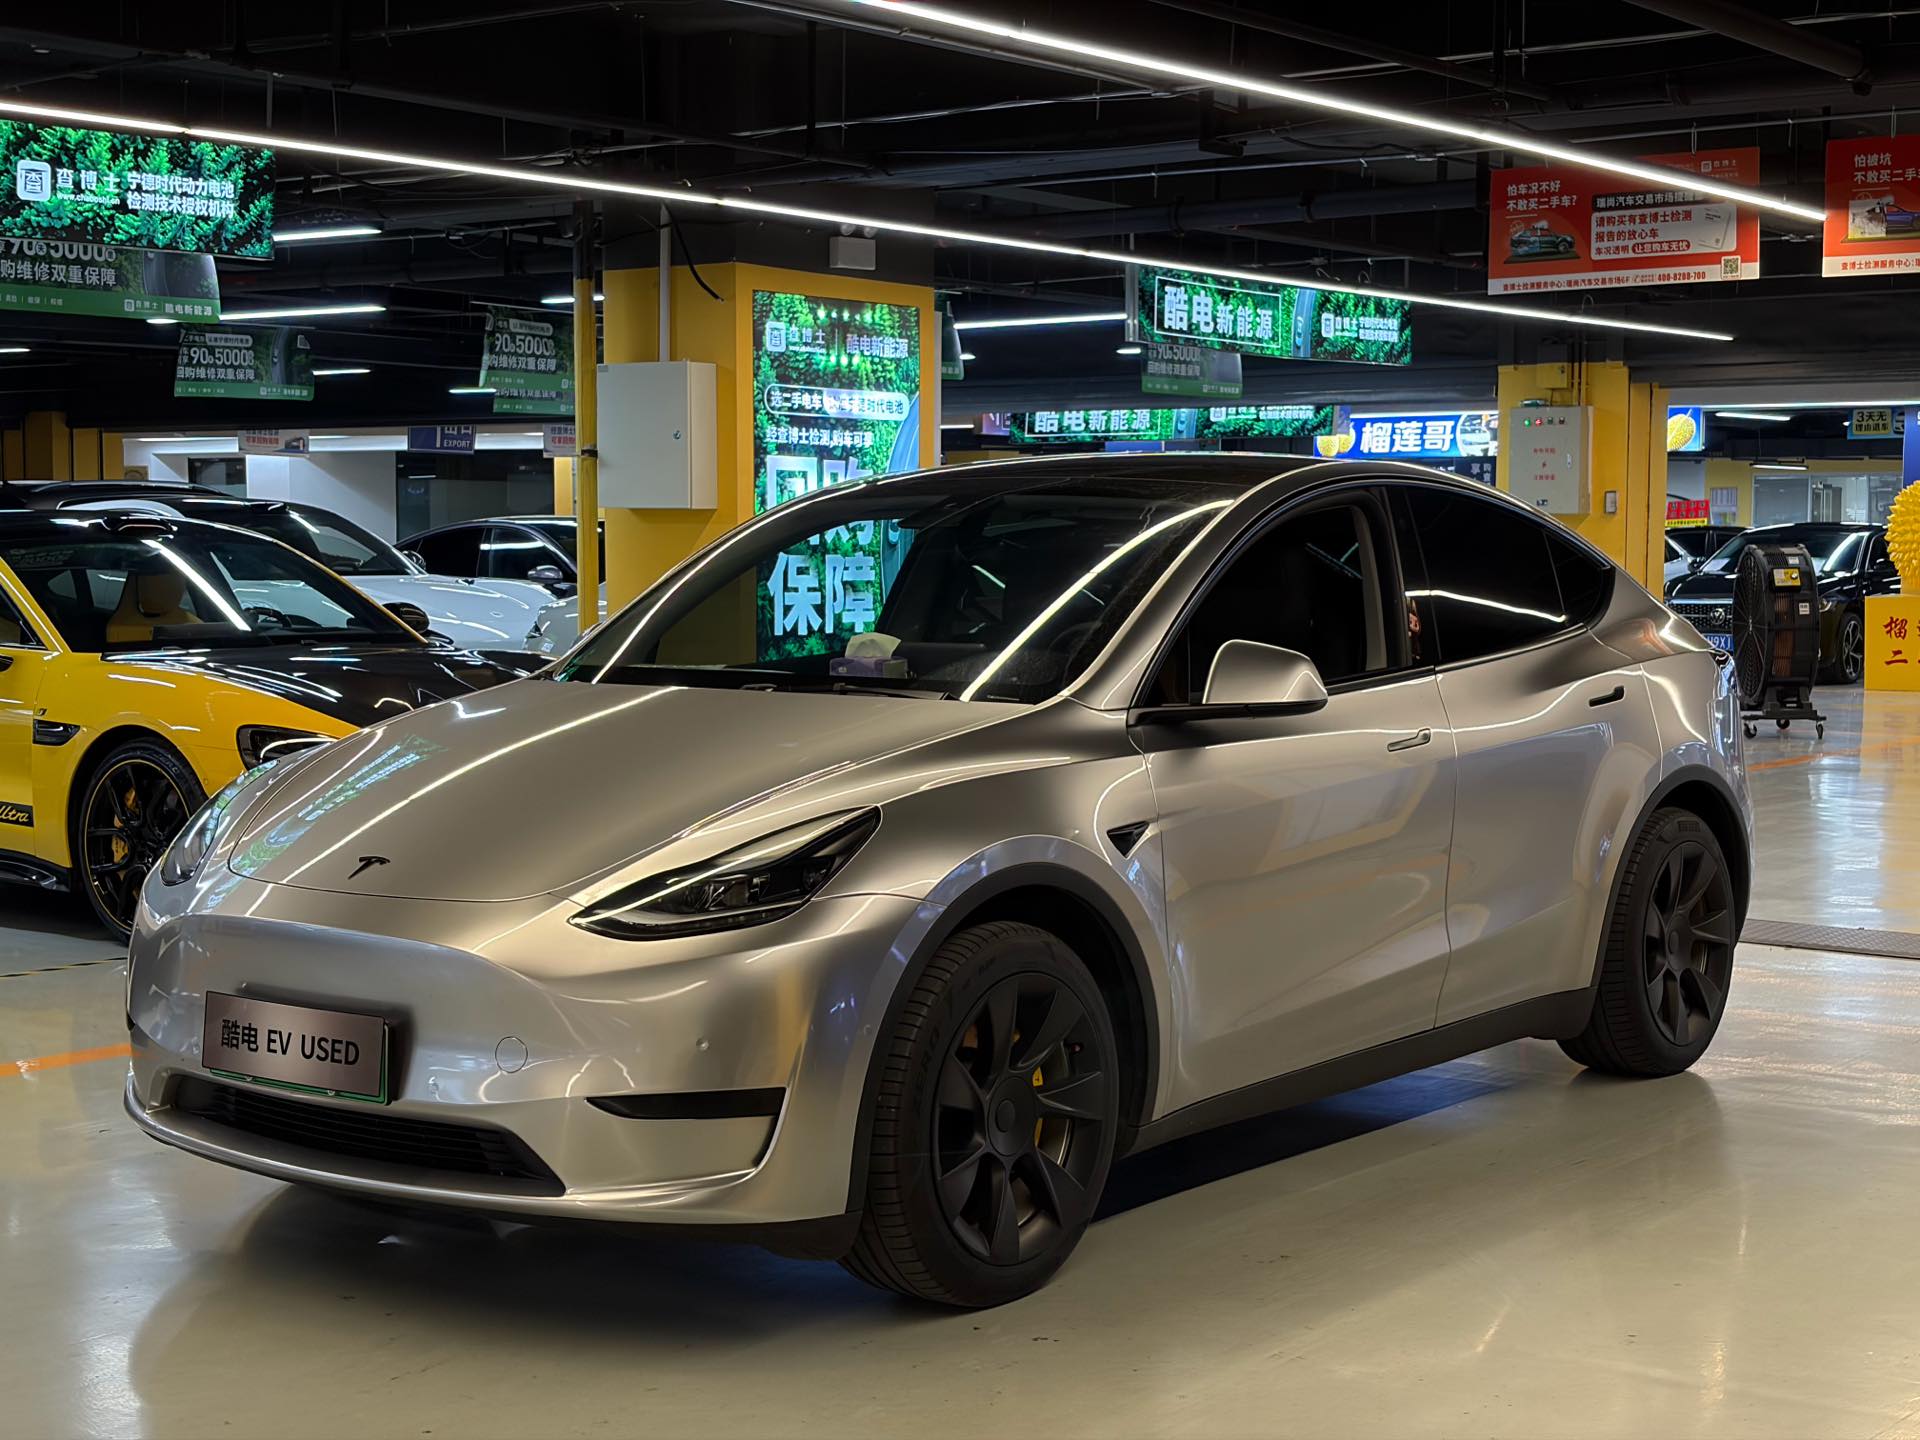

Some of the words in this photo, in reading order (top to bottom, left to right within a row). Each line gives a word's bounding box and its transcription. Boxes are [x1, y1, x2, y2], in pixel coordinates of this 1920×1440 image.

[1854, 153, 1892, 168] 怕被坑
[56, 168, 121, 192] 查博士
[126, 171, 235, 199] 宁德时代动力电池
[1853, 168, 1920, 184] 不敢买二手
[1507, 180, 1560, 197] 怕车况不好
[126, 191, 235, 219] 检测技术授权机构
[1506, 195, 1577, 212] 不敢买二手车?
[1595, 210, 1692, 228] 请购买有查博士检测
[1595, 228, 1659, 243] 报告的放心车
[1164, 285, 1273, 340] 酷电新能源
[846, 333, 908, 358] 酷电新能源
[1034, 409, 1151, 433] 酷电新能源
[1856, 411, 1888, 422] 3天无
[443, 439, 471, 448] EXPORT
[1360, 421, 1456, 454] 榴莲哥
[767, 552, 876, 636] 保障
[1883, 616, 1920, 640] 榴
[1884, 649, 1920, 666] 二
[221, 1019, 259, 1052] 酷电
[267, 1029, 292, 1055] EV
[301, 1034, 360, 1066] USED
